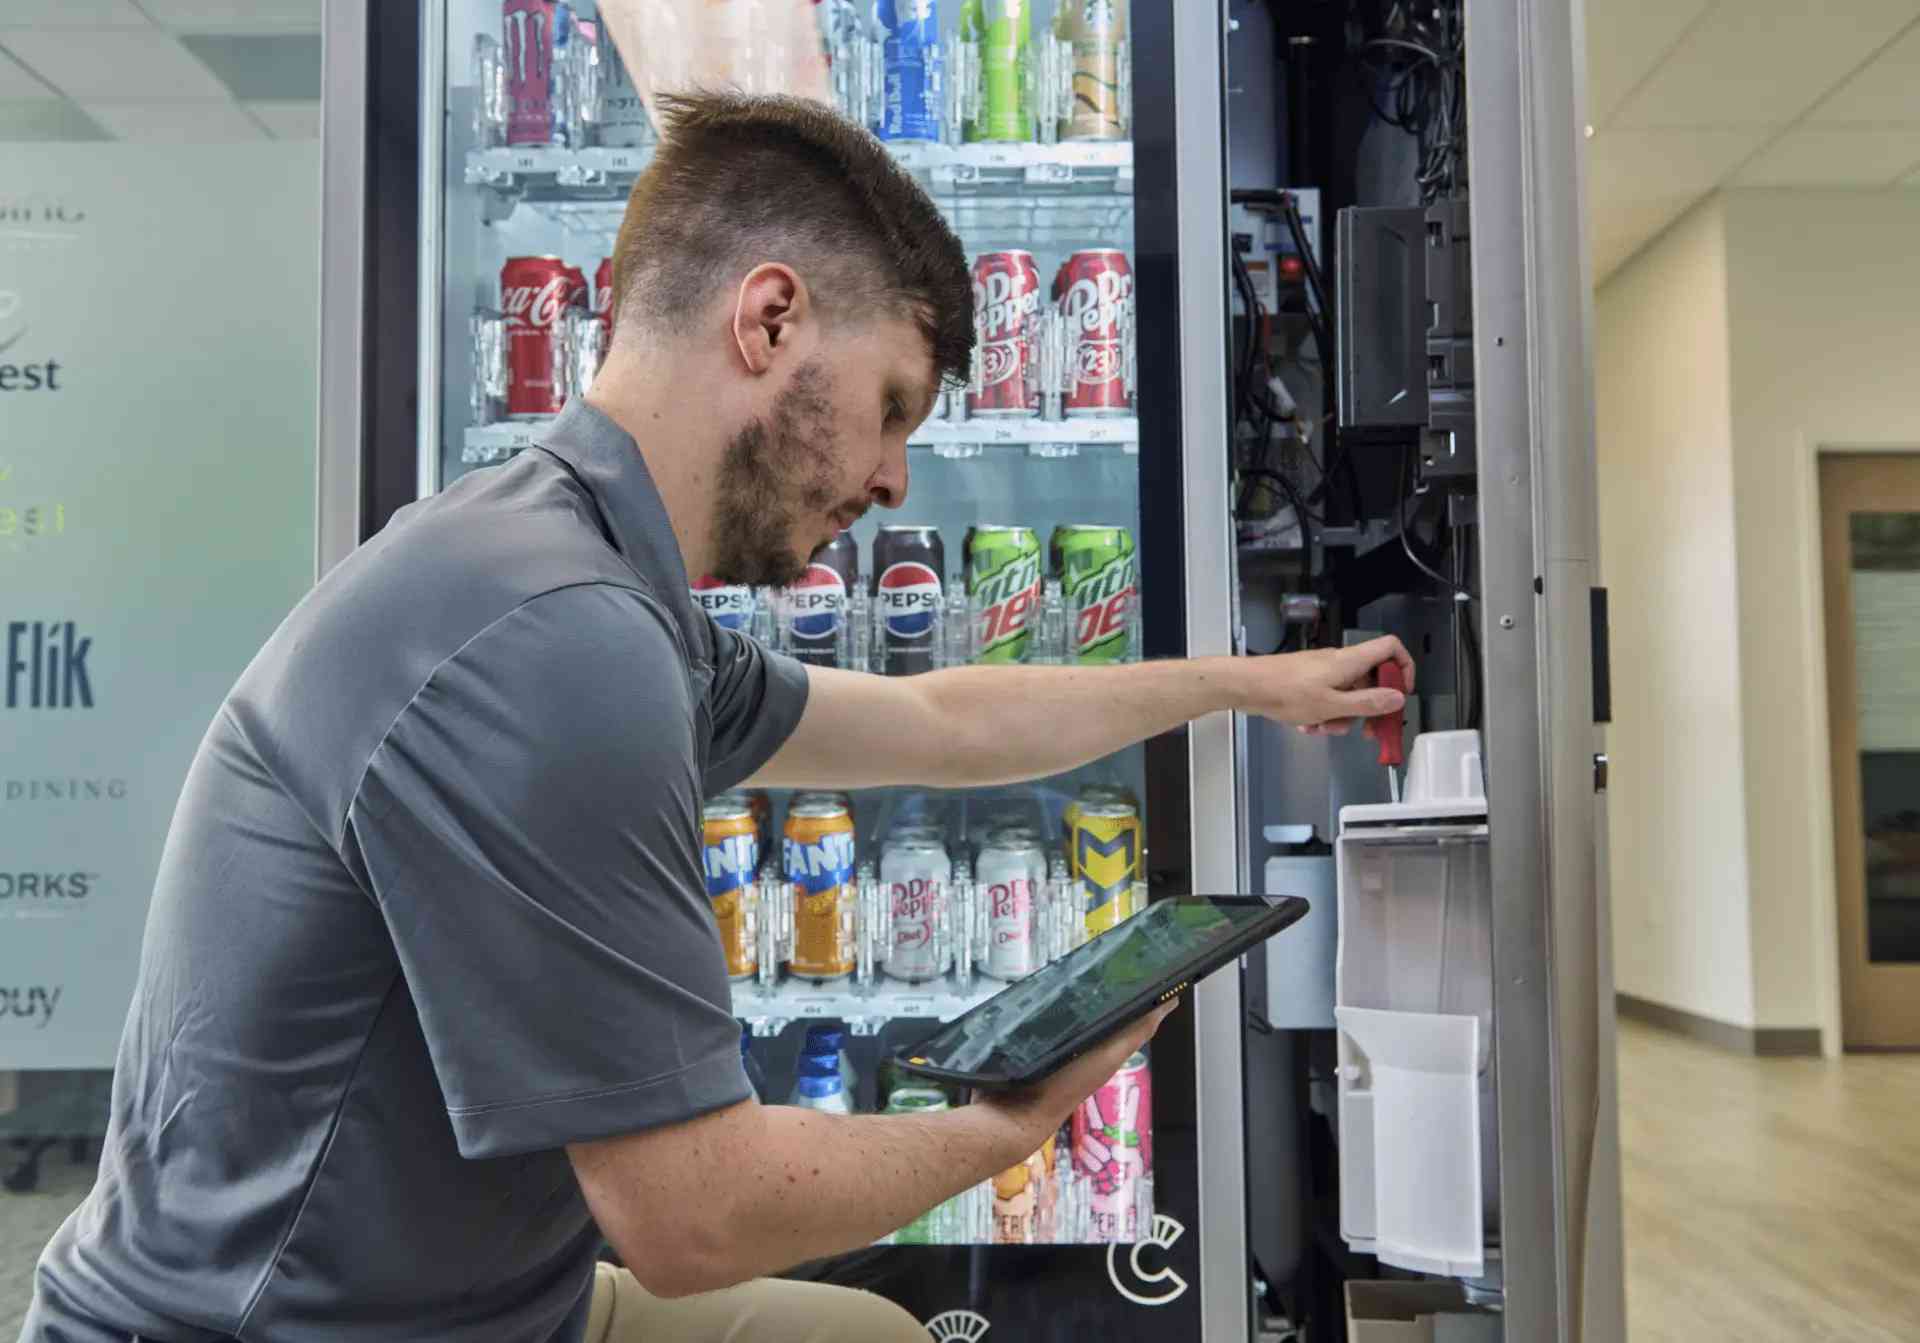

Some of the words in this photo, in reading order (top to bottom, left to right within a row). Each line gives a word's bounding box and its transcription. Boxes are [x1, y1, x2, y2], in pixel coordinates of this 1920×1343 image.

[987, 271, 1026, 306] Dr
[1096, 270, 1132, 304] Dr
[0, 358, 62, 392] est
[5, 620, 94, 709] Flík
[5, 779, 127, 801] DINING
